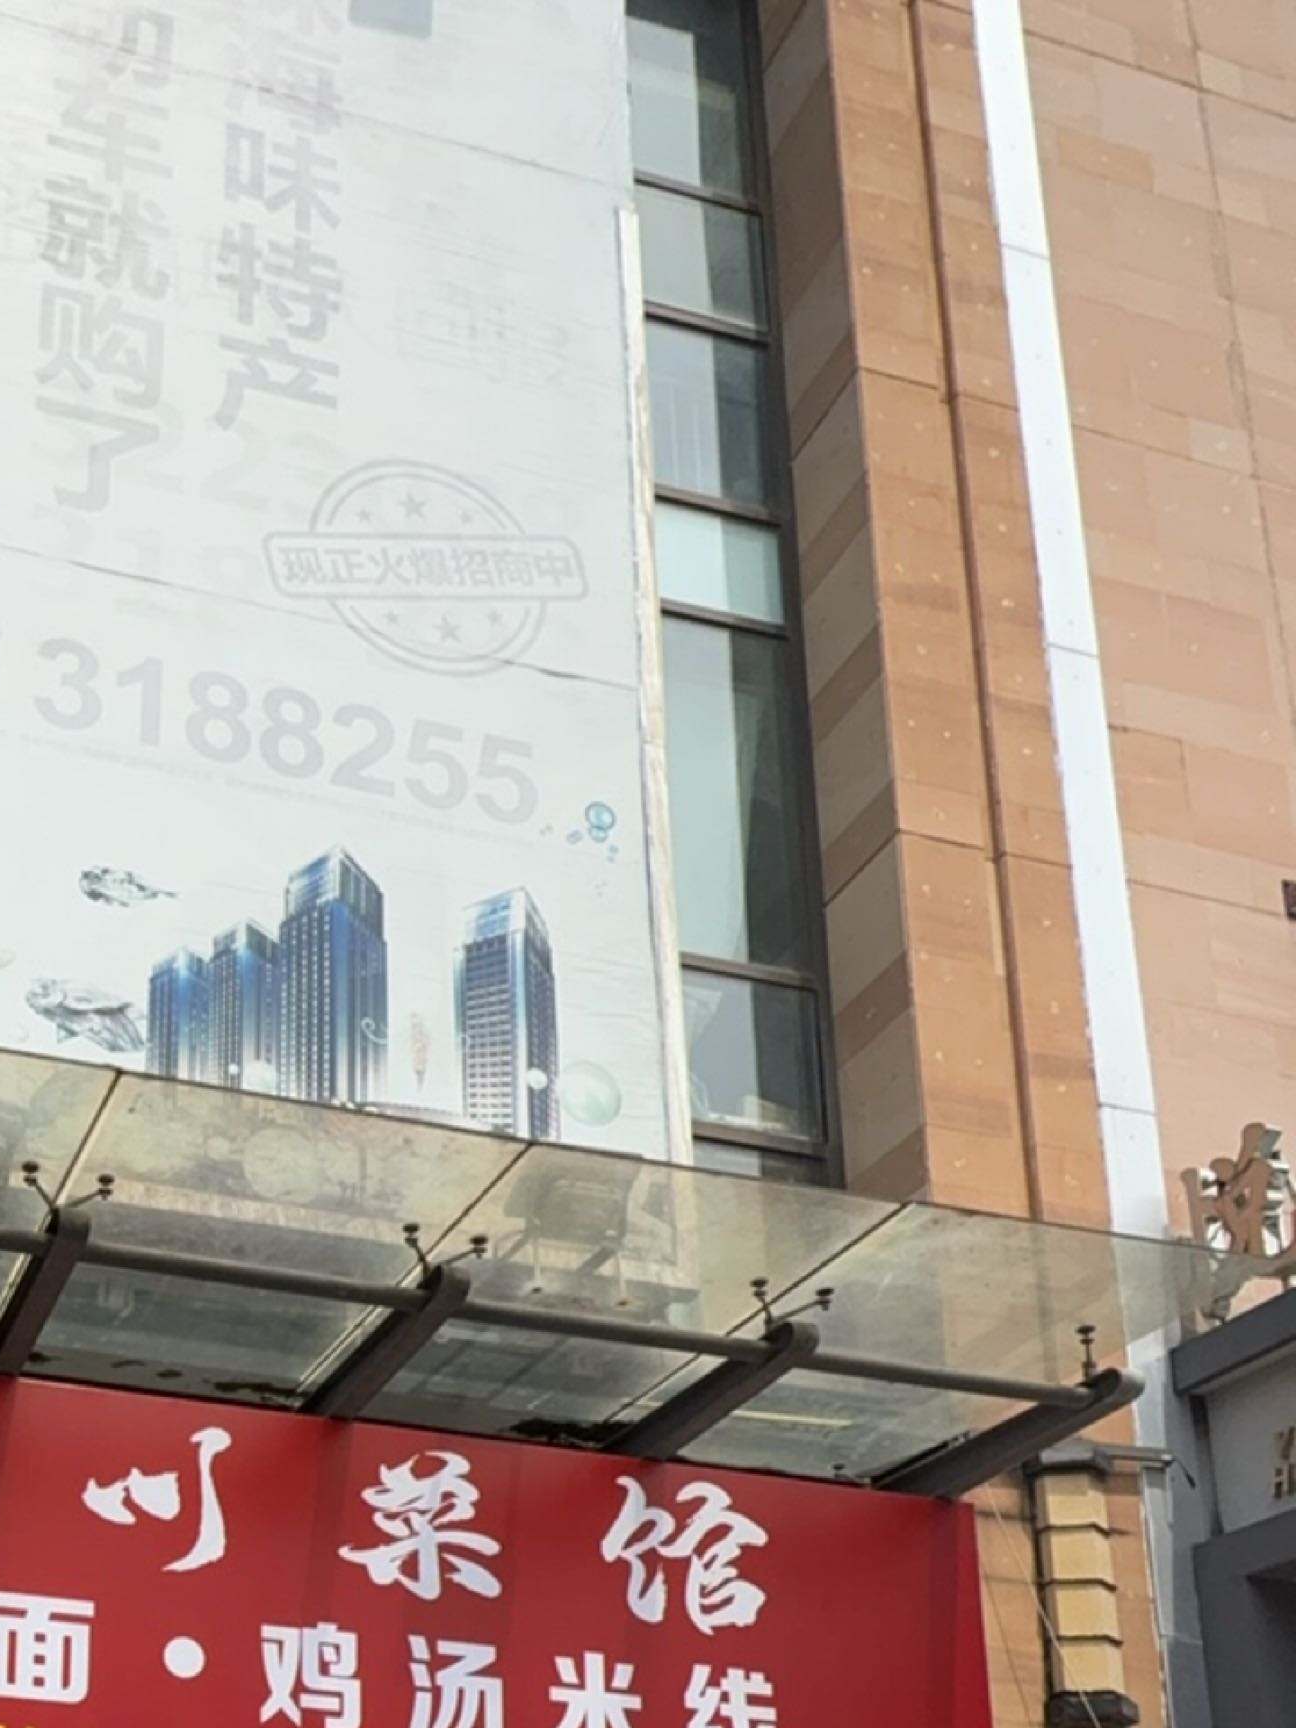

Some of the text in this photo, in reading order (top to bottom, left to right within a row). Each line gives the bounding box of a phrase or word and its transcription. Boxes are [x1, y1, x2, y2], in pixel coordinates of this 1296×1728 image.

[280, 542, 574, 592] 现正火爆招商中
[33, 637, 540, 826] 3188255
